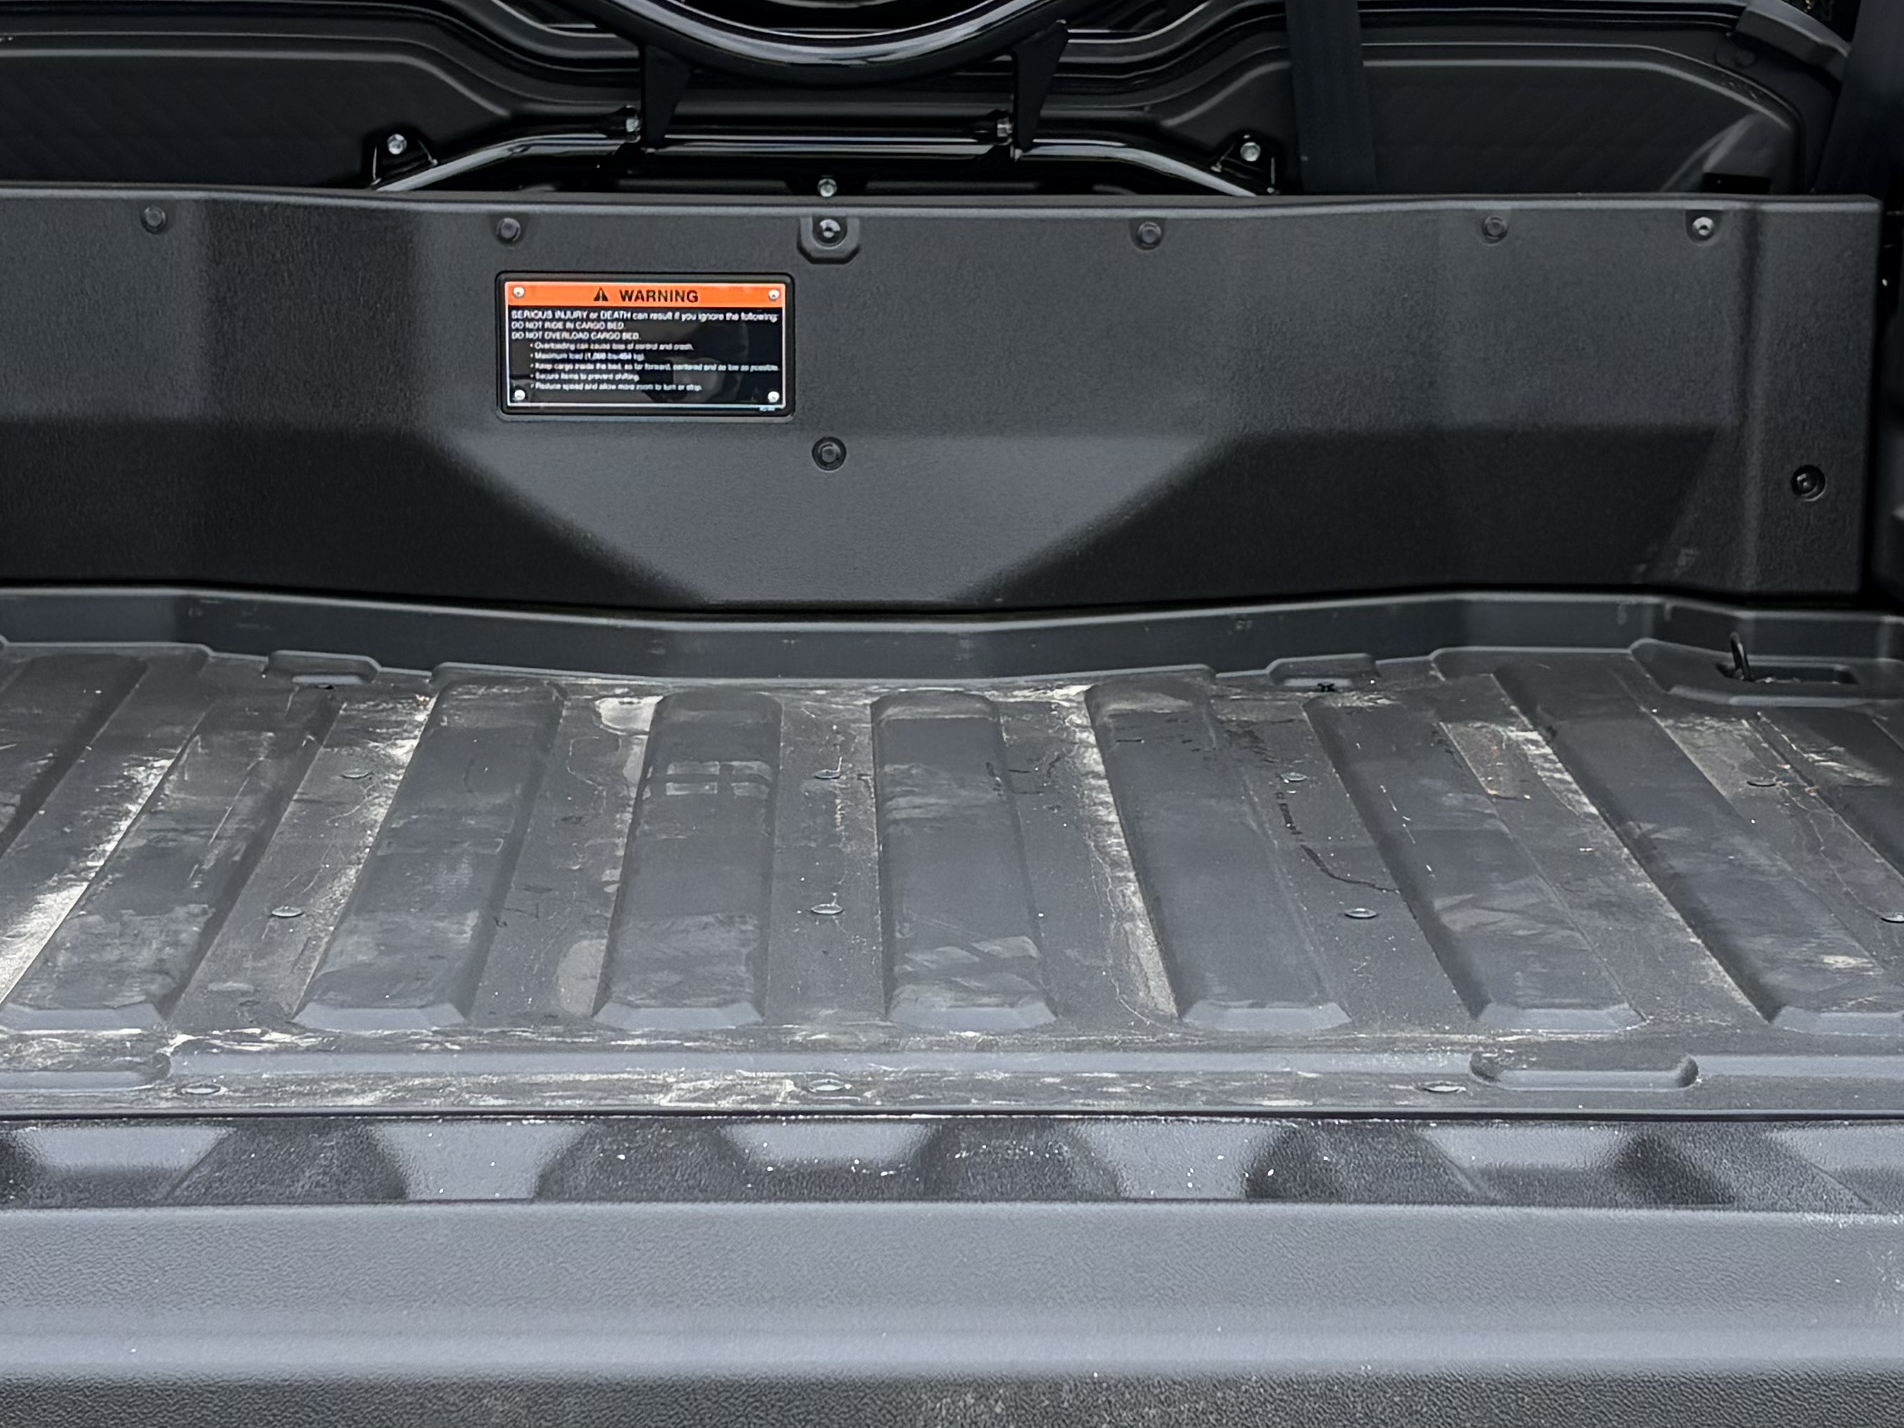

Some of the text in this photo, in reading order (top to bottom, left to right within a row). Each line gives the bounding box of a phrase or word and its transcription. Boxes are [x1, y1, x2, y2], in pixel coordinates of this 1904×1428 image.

[619, 289, 699, 303] WARNING
[511, 310, 553, 320] SERIOUS
[554, 310, 588, 320] INJURY
[589, 312, 599, 320] or
[599, 310, 631, 320] DEATH
[632, 312, 648, 320] can
[649, 311, 673, 321] result
[681, 313, 697, 322] you
[698, 311, 724, 323] ignore
[725, 312, 739, 321] the
[511, 321, 524, 330] DO
[525, 321, 542, 330] NOT
[544, 321, 564, 330] RIDE
[565, 321, 574, 330] IN
[576, 321, 606, 330] CARGO
[511, 331, 524, 340] DO
[525, 331, 542, 340] NOT
[544, 331, 590, 340] OVERLOAD
[590, 331, 621, 340] CARGO
